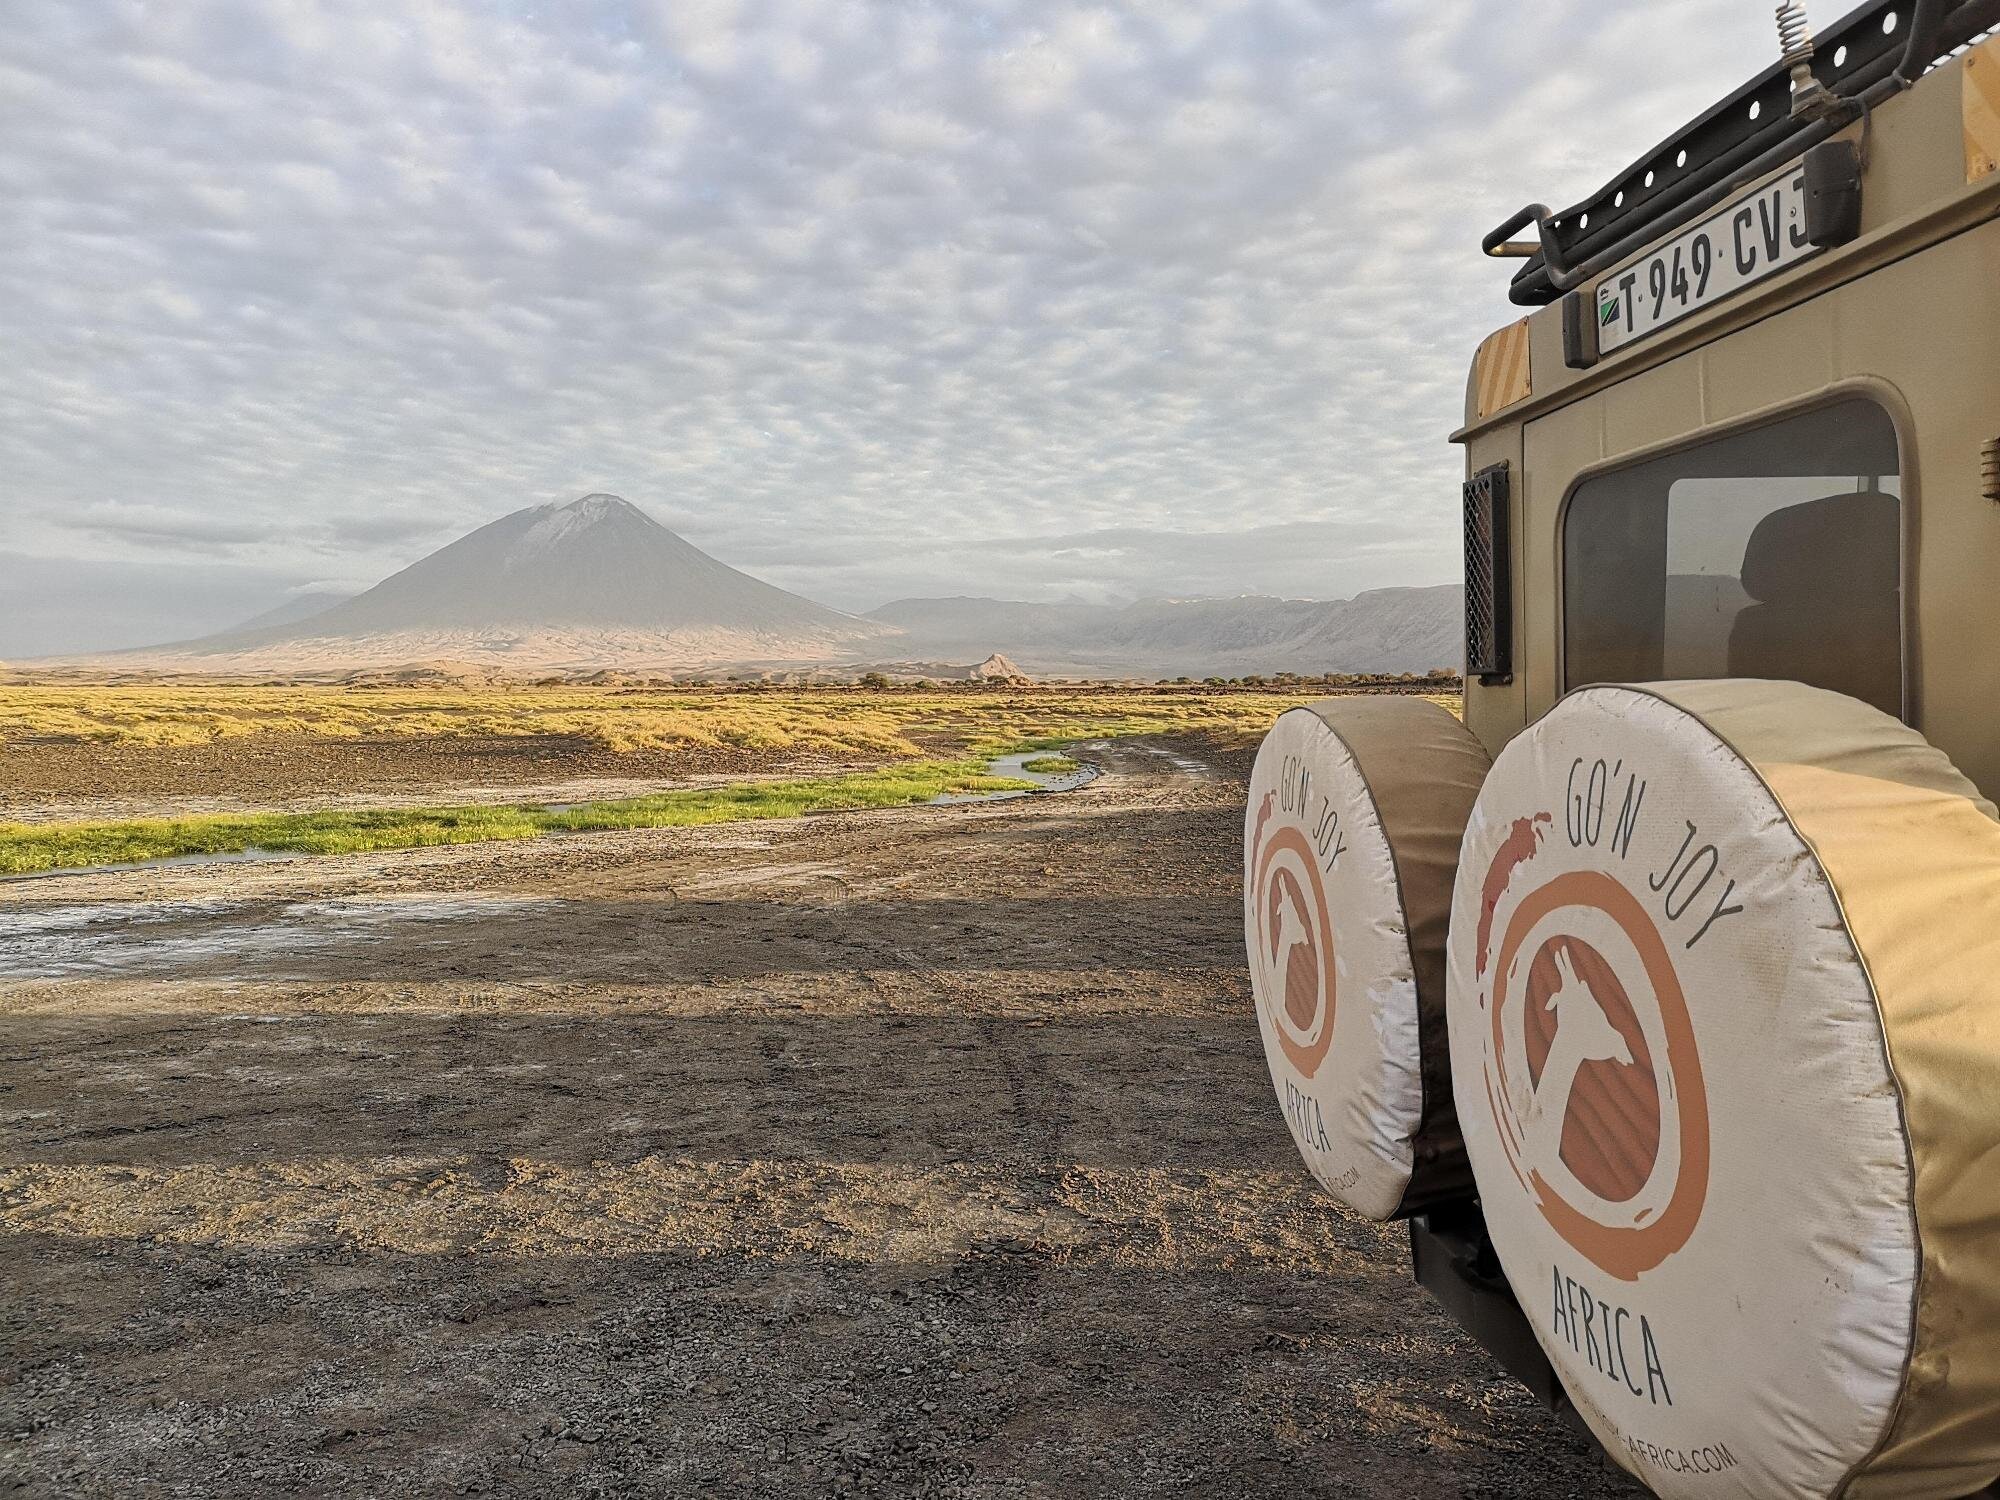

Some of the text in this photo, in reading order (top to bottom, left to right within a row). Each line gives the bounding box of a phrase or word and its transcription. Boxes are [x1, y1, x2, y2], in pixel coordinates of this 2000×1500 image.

[1312, 795, 1347, 874] JOY
[1566, 757, 1744, 949] GO'N JOY
[1286, 1078, 1331, 1152] AFRICA
[1553, 1264, 1672, 1406] AFRICA
